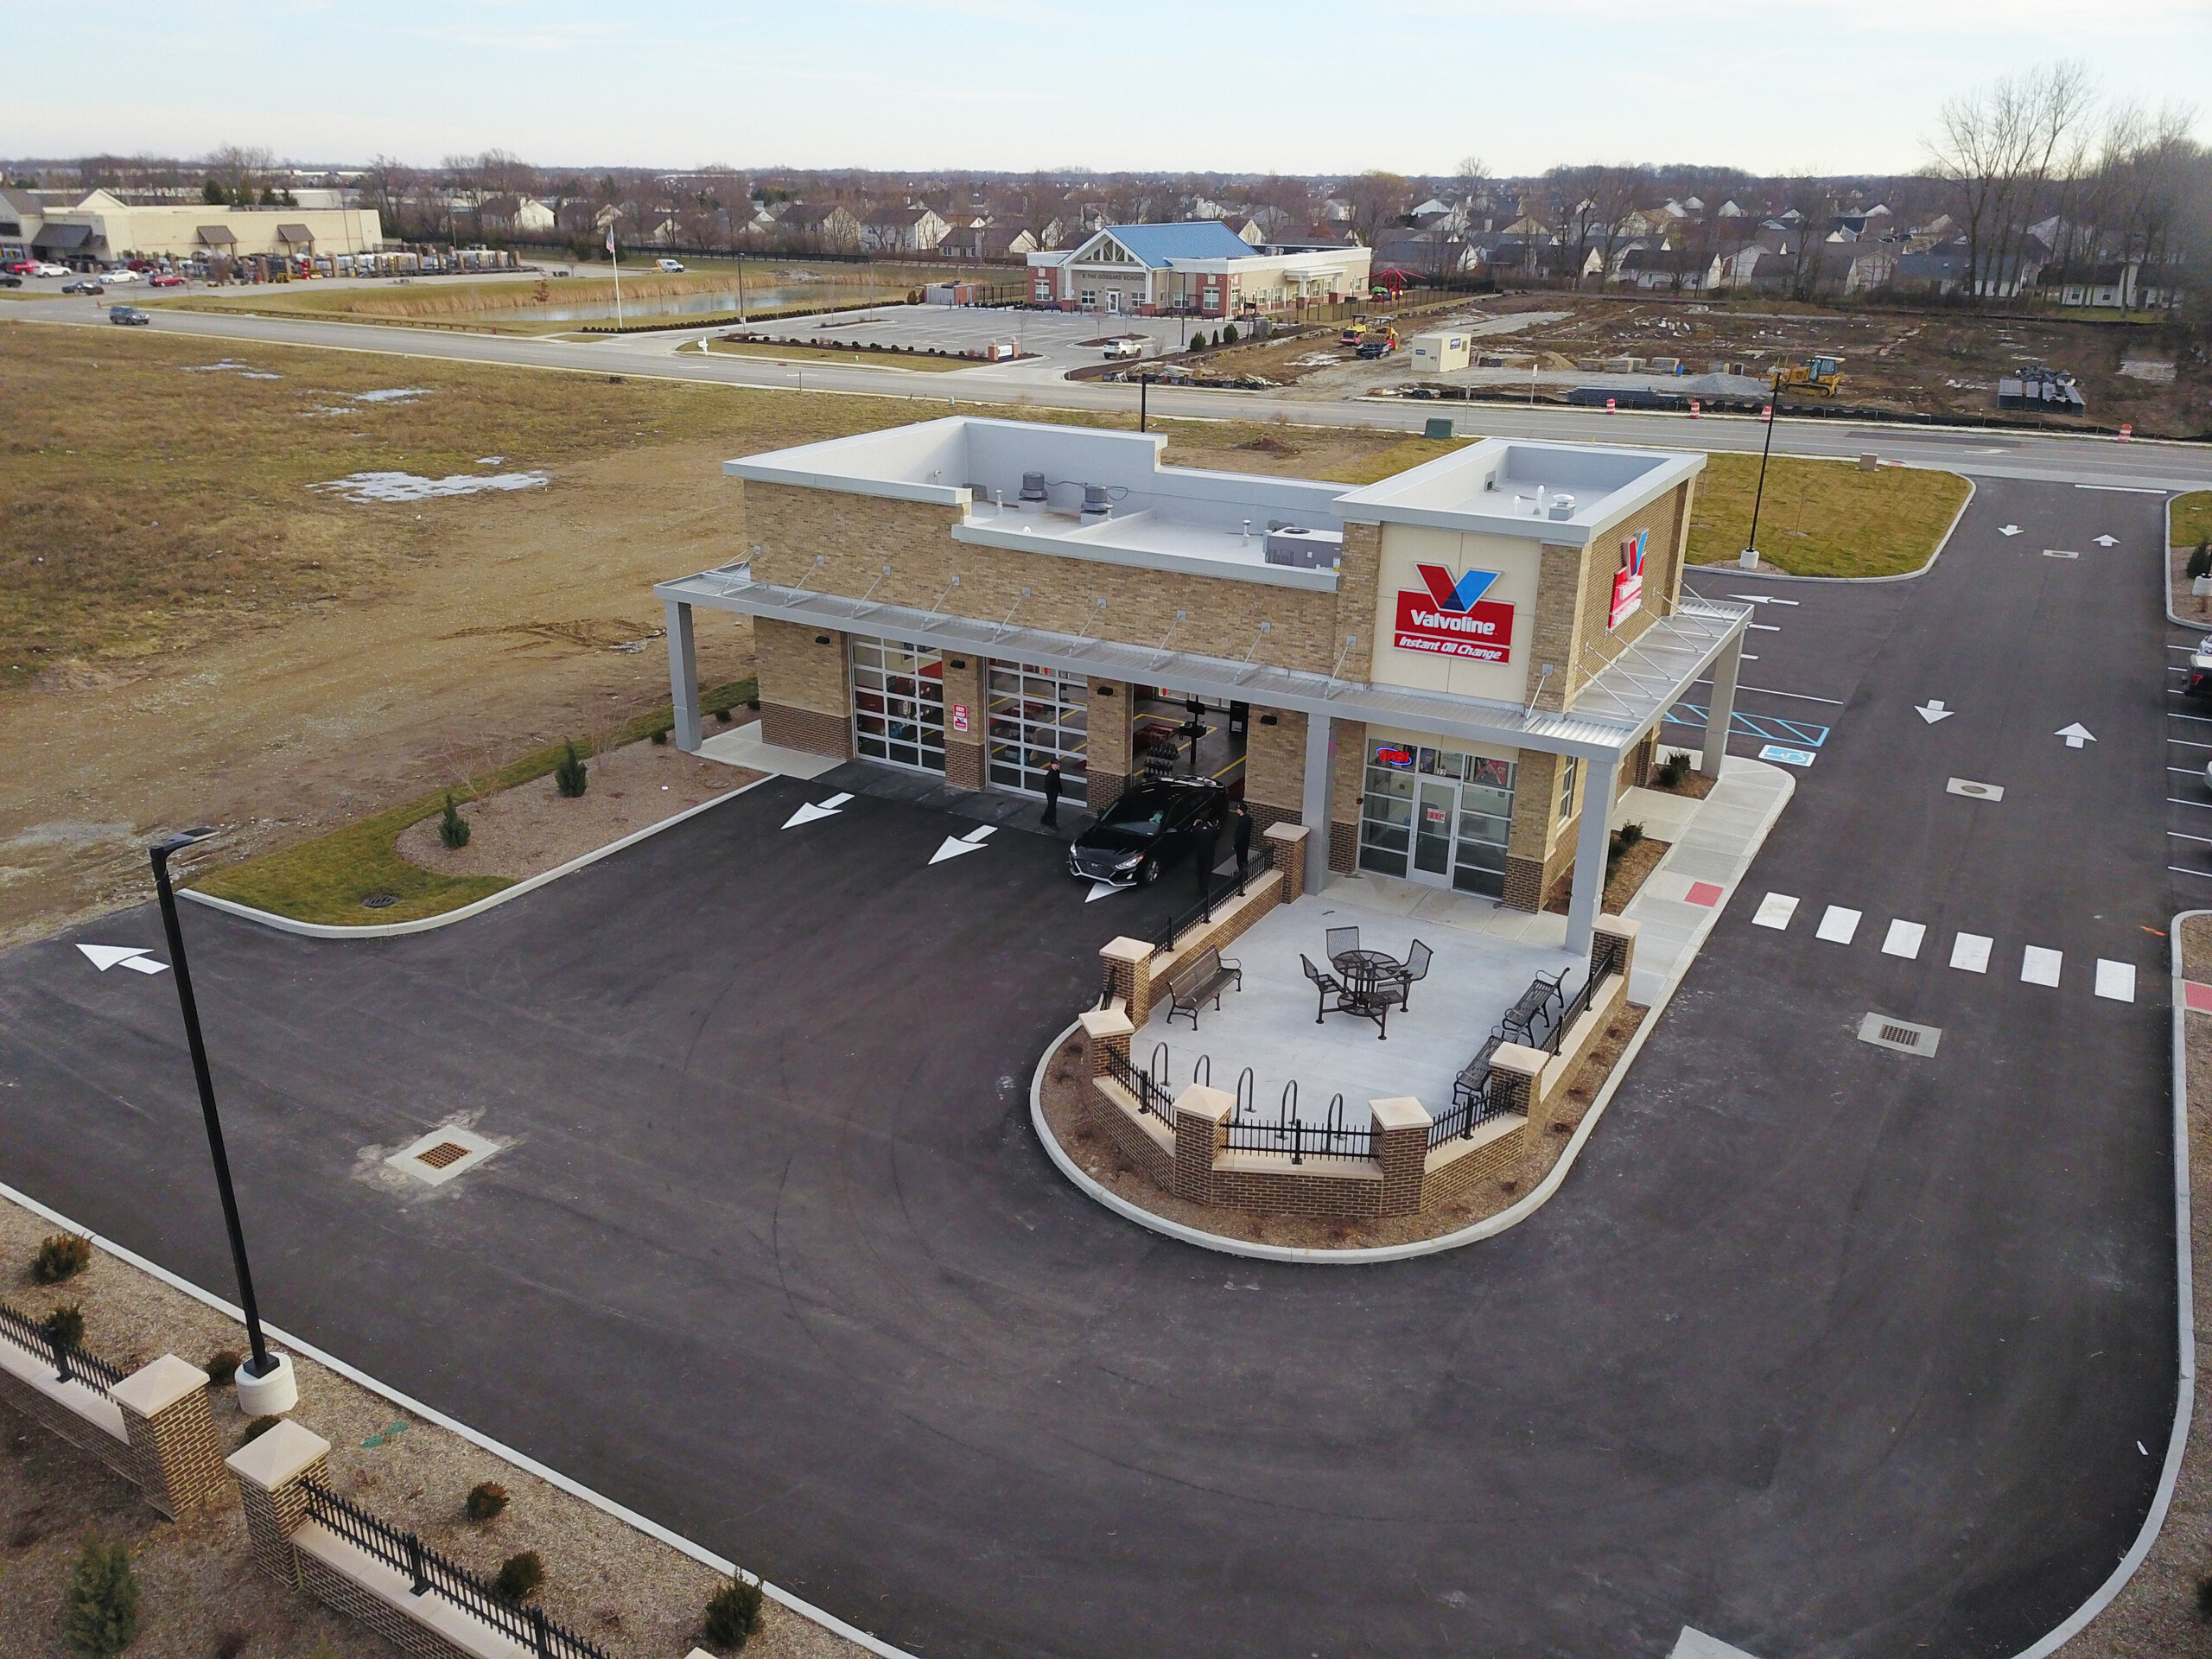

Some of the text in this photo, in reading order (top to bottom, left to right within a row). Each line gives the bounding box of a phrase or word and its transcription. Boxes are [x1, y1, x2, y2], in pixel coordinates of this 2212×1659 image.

[1410, 609, 1496, 636] Valvoline
[1399, 636, 1503, 660] Instant Oil Change
[1379, 749, 1410, 763] OPEN
